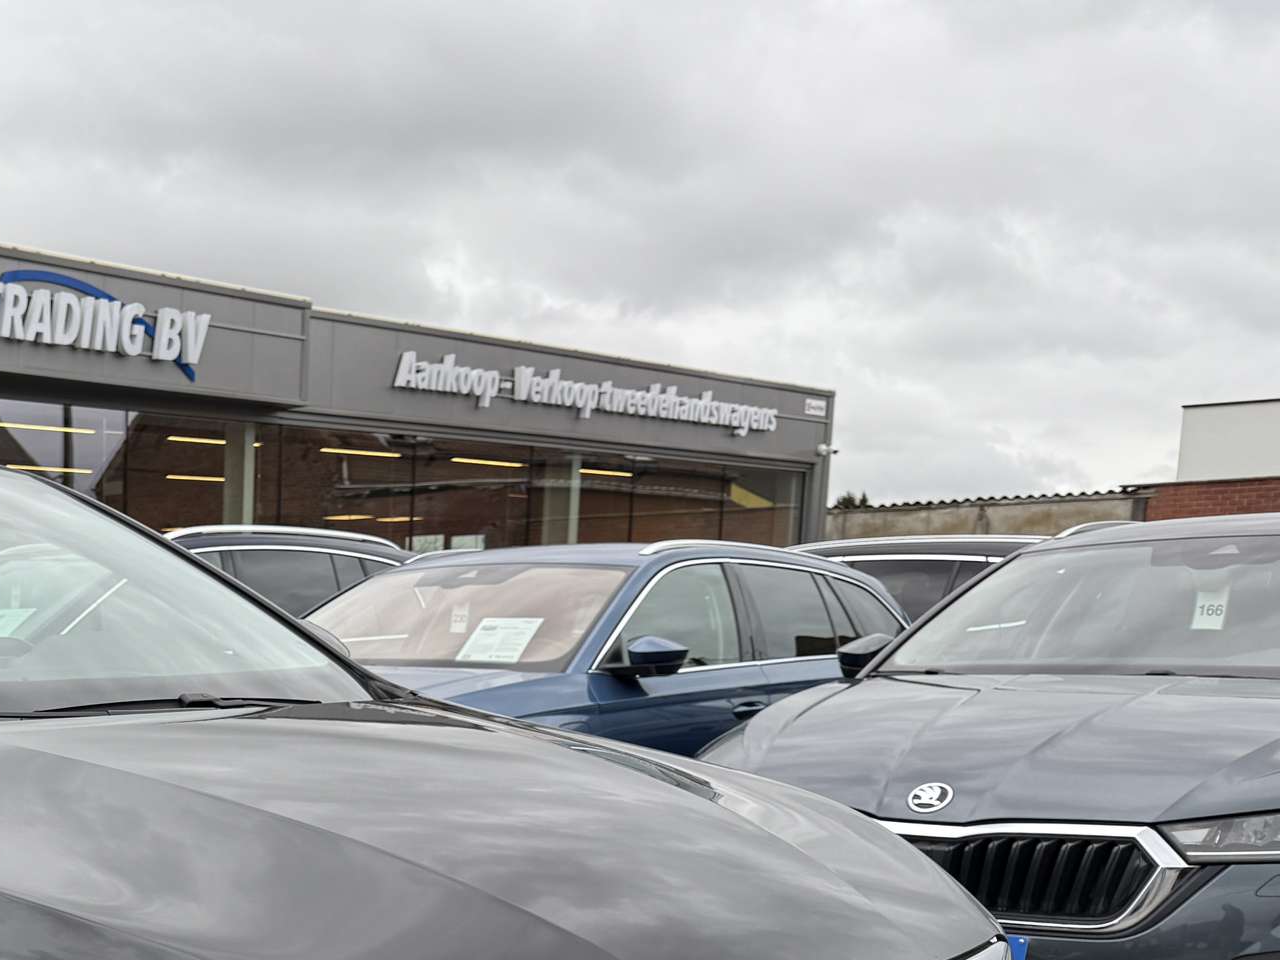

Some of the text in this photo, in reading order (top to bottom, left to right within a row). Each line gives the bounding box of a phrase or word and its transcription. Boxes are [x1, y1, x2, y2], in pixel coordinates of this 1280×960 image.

[152, 307, 211, 364] BV
[393, 351, 500, 407] Aankoop
[514, 366, 599, 418] Verkoop
[600, 380, 778, 437] tweedehandswagens
[1198, 603, 1224, 617] 166
